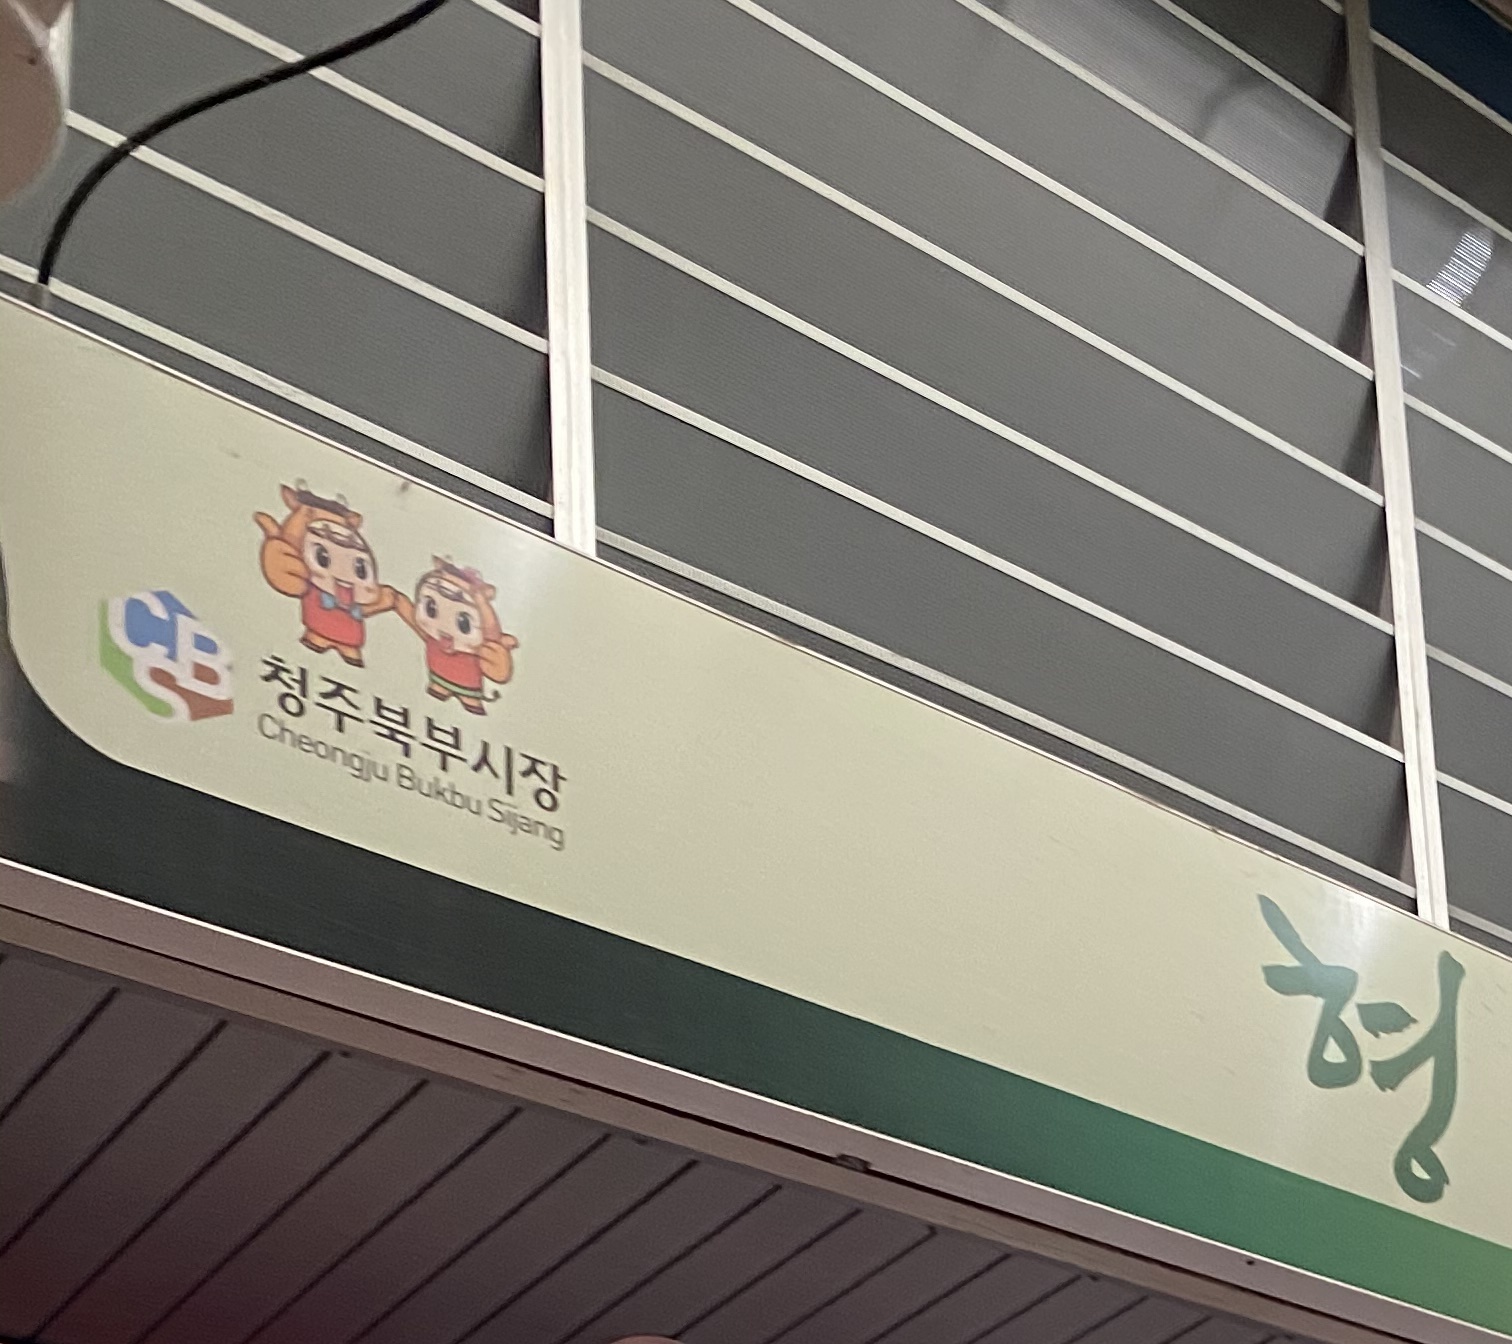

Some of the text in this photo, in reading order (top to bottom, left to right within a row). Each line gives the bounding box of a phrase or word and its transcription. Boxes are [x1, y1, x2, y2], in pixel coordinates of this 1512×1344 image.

[257, 712, 565, 852] Cheongju Bukbu Sijang
[259, 654, 567, 813] 청주북부시장
